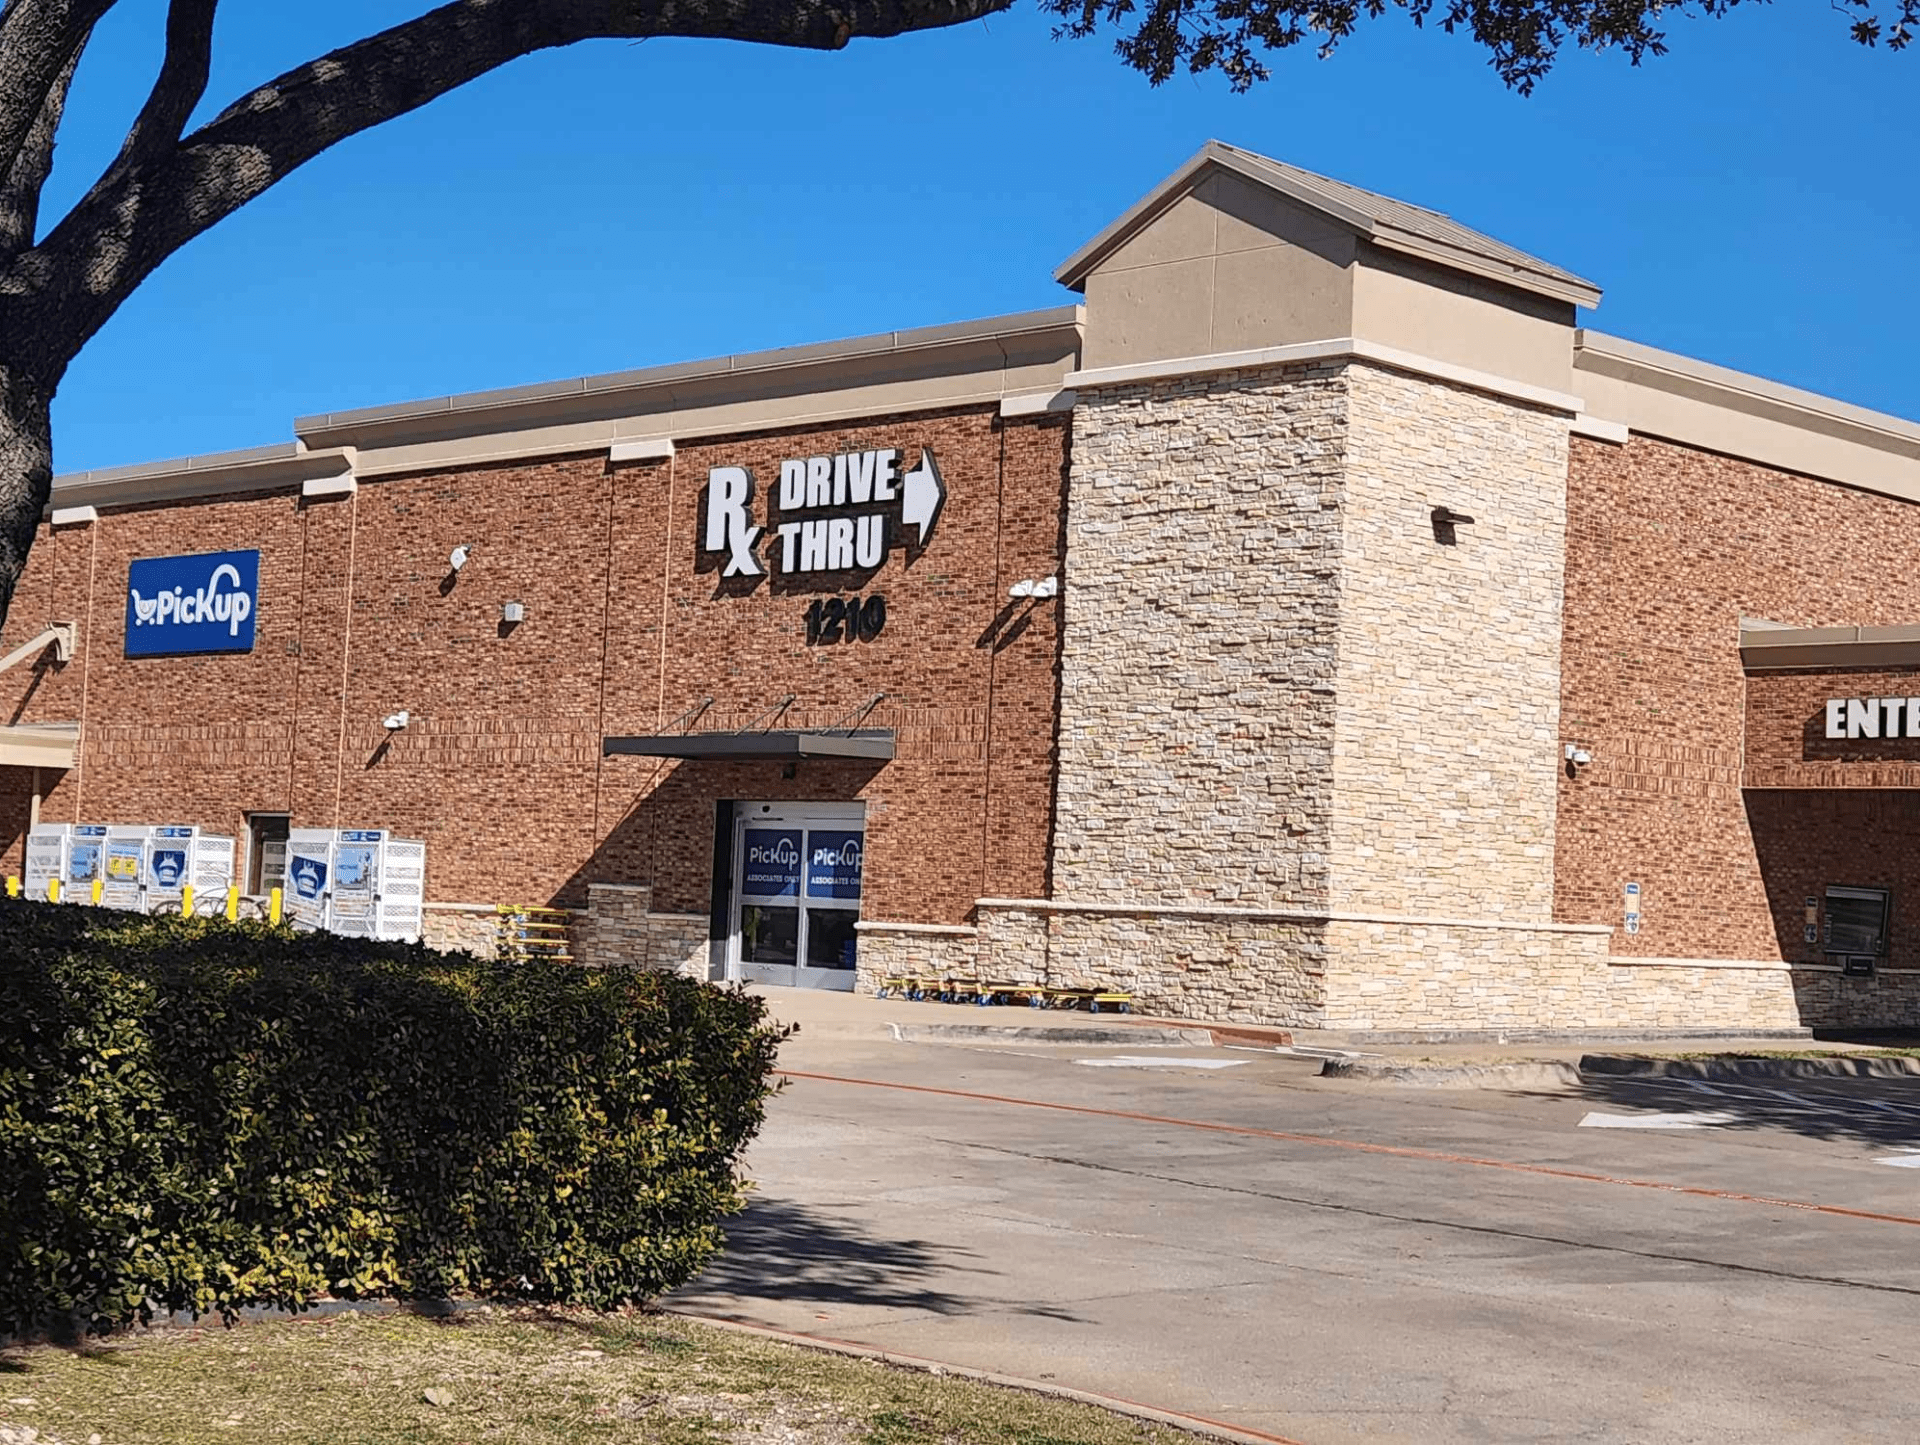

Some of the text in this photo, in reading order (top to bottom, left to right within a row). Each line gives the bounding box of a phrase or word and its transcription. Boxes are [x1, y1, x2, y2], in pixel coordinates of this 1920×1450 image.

[779, 449, 896, 511] DRIVE
[778, 514, 884, 574] THRU
[804, 595, 887, 645] 1210
[810, 876, 850, 885] ASSOCIATES
